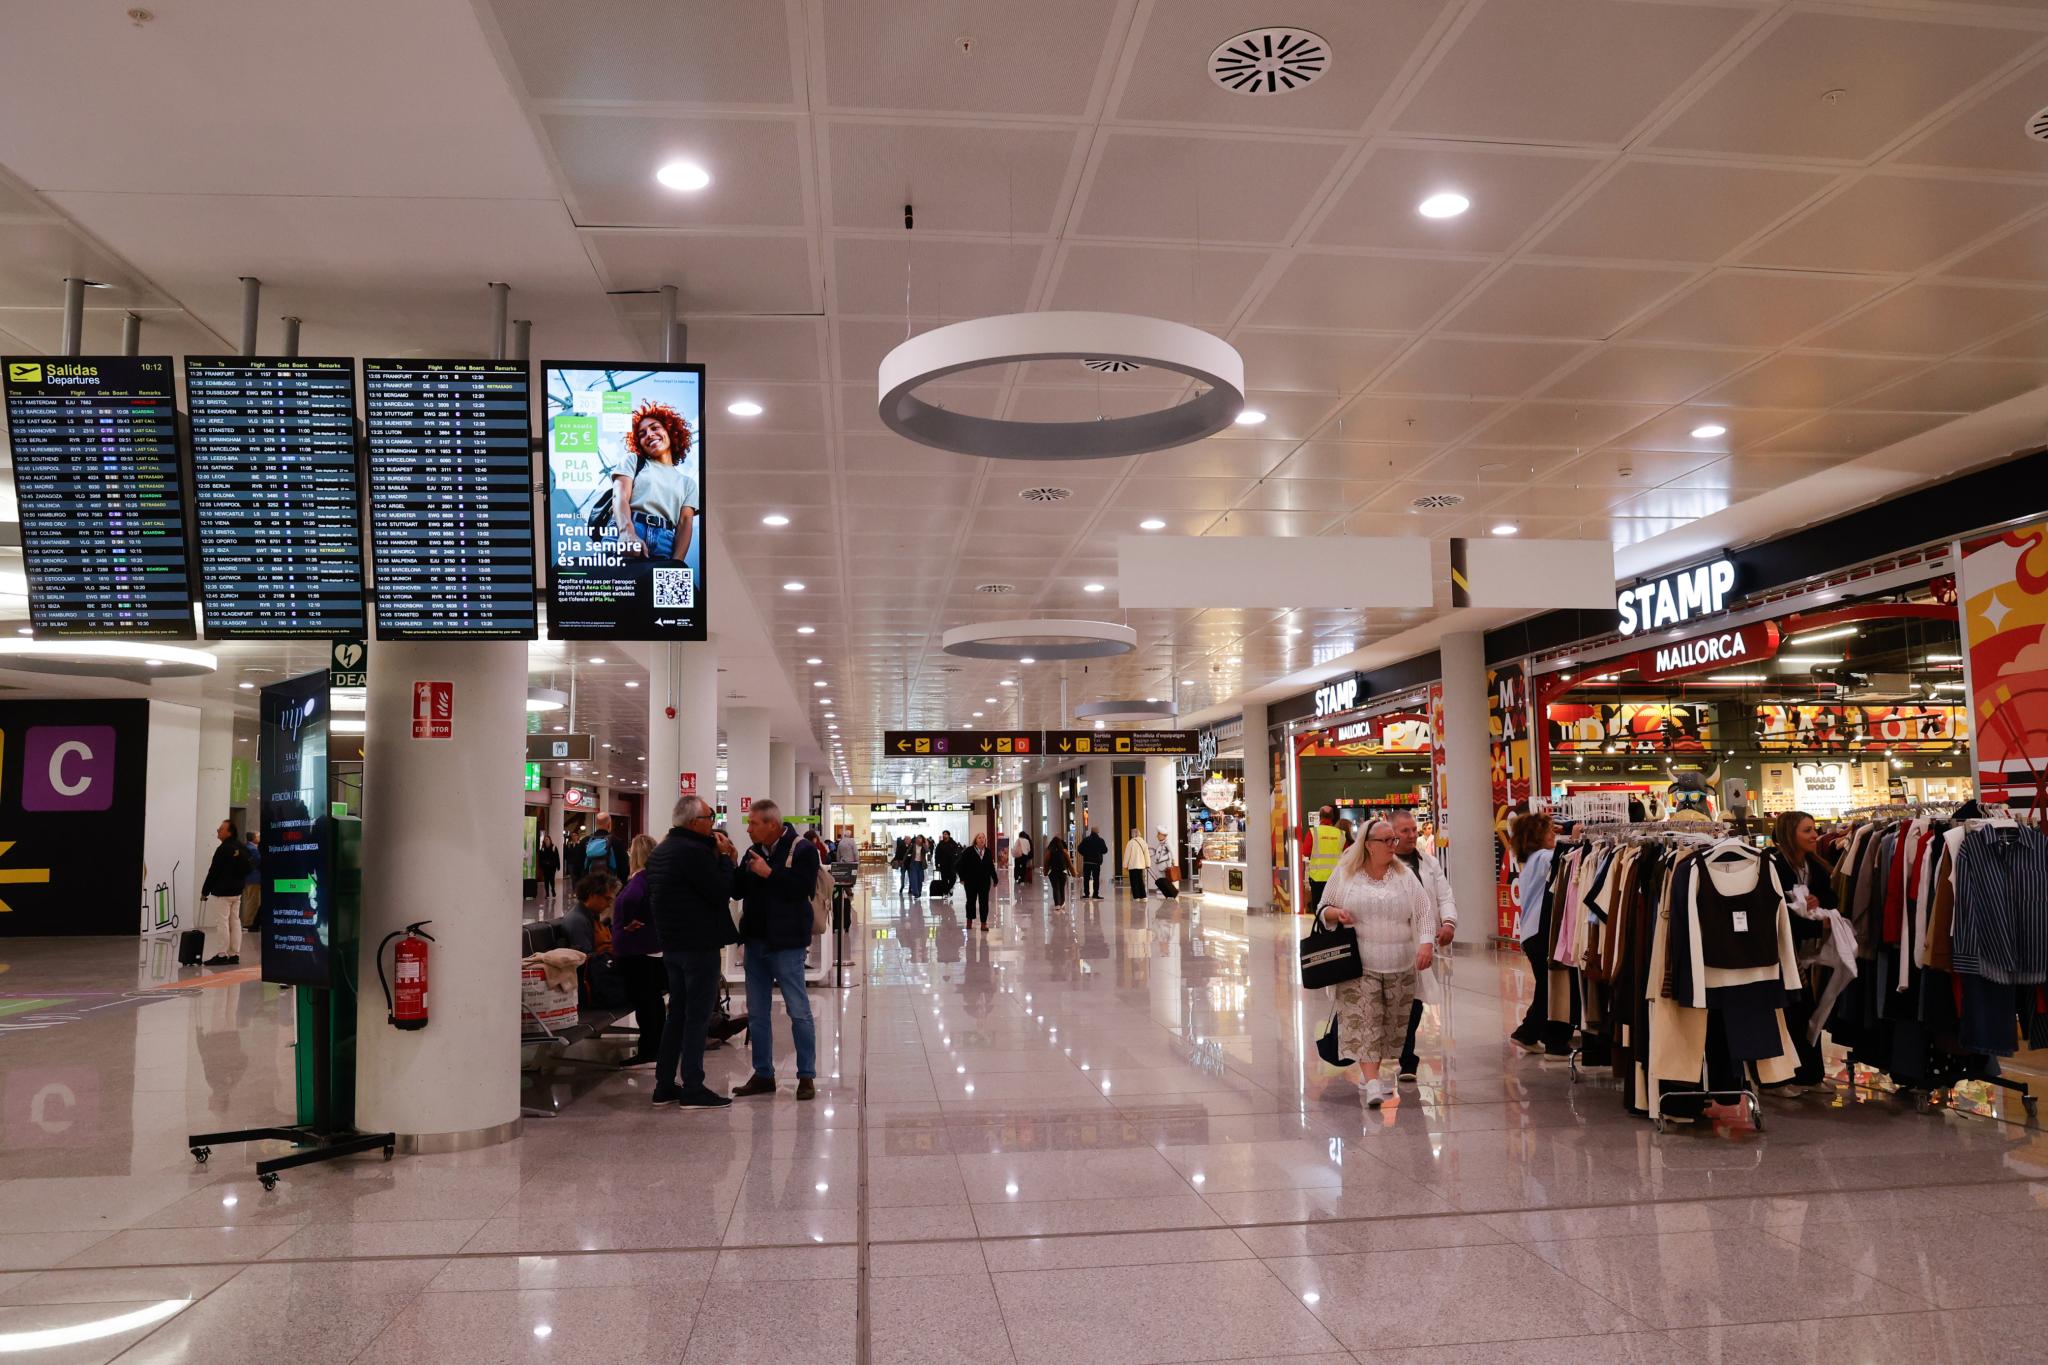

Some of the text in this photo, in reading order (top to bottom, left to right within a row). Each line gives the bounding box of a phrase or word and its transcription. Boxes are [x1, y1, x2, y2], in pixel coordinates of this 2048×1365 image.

[46, 364, 98, 376] Salidas
[47, 376, 100, 386] Departures
[560, 432, 590, 446] 25 €
[566, 460, 588, 470] PLA
[562, 472, 592, 481] PLUS
[557, 524, 617, 536] Tenir un
[558, 541, 641, 554] pla sempre
[558, 553, 626, 566] és millor.
[1618, 560, 1735, 635] STAMP
[1656, 632, 1746, 673] MALLORCA
[336, 674, 366, 686] DEA
[1315, 679, 1358, 717] STAMP
[281, 699, 303, 741] vip
[1338, 721, 1371, 741] MALLORCA
[937, 741, 944, 750] C
[1018, 741, 1025, 750] D
[49, 741, 93, 796] C
[1805, 776, 1836, 784] SHADES
[1807, 783, 1836, 791] WORLD
